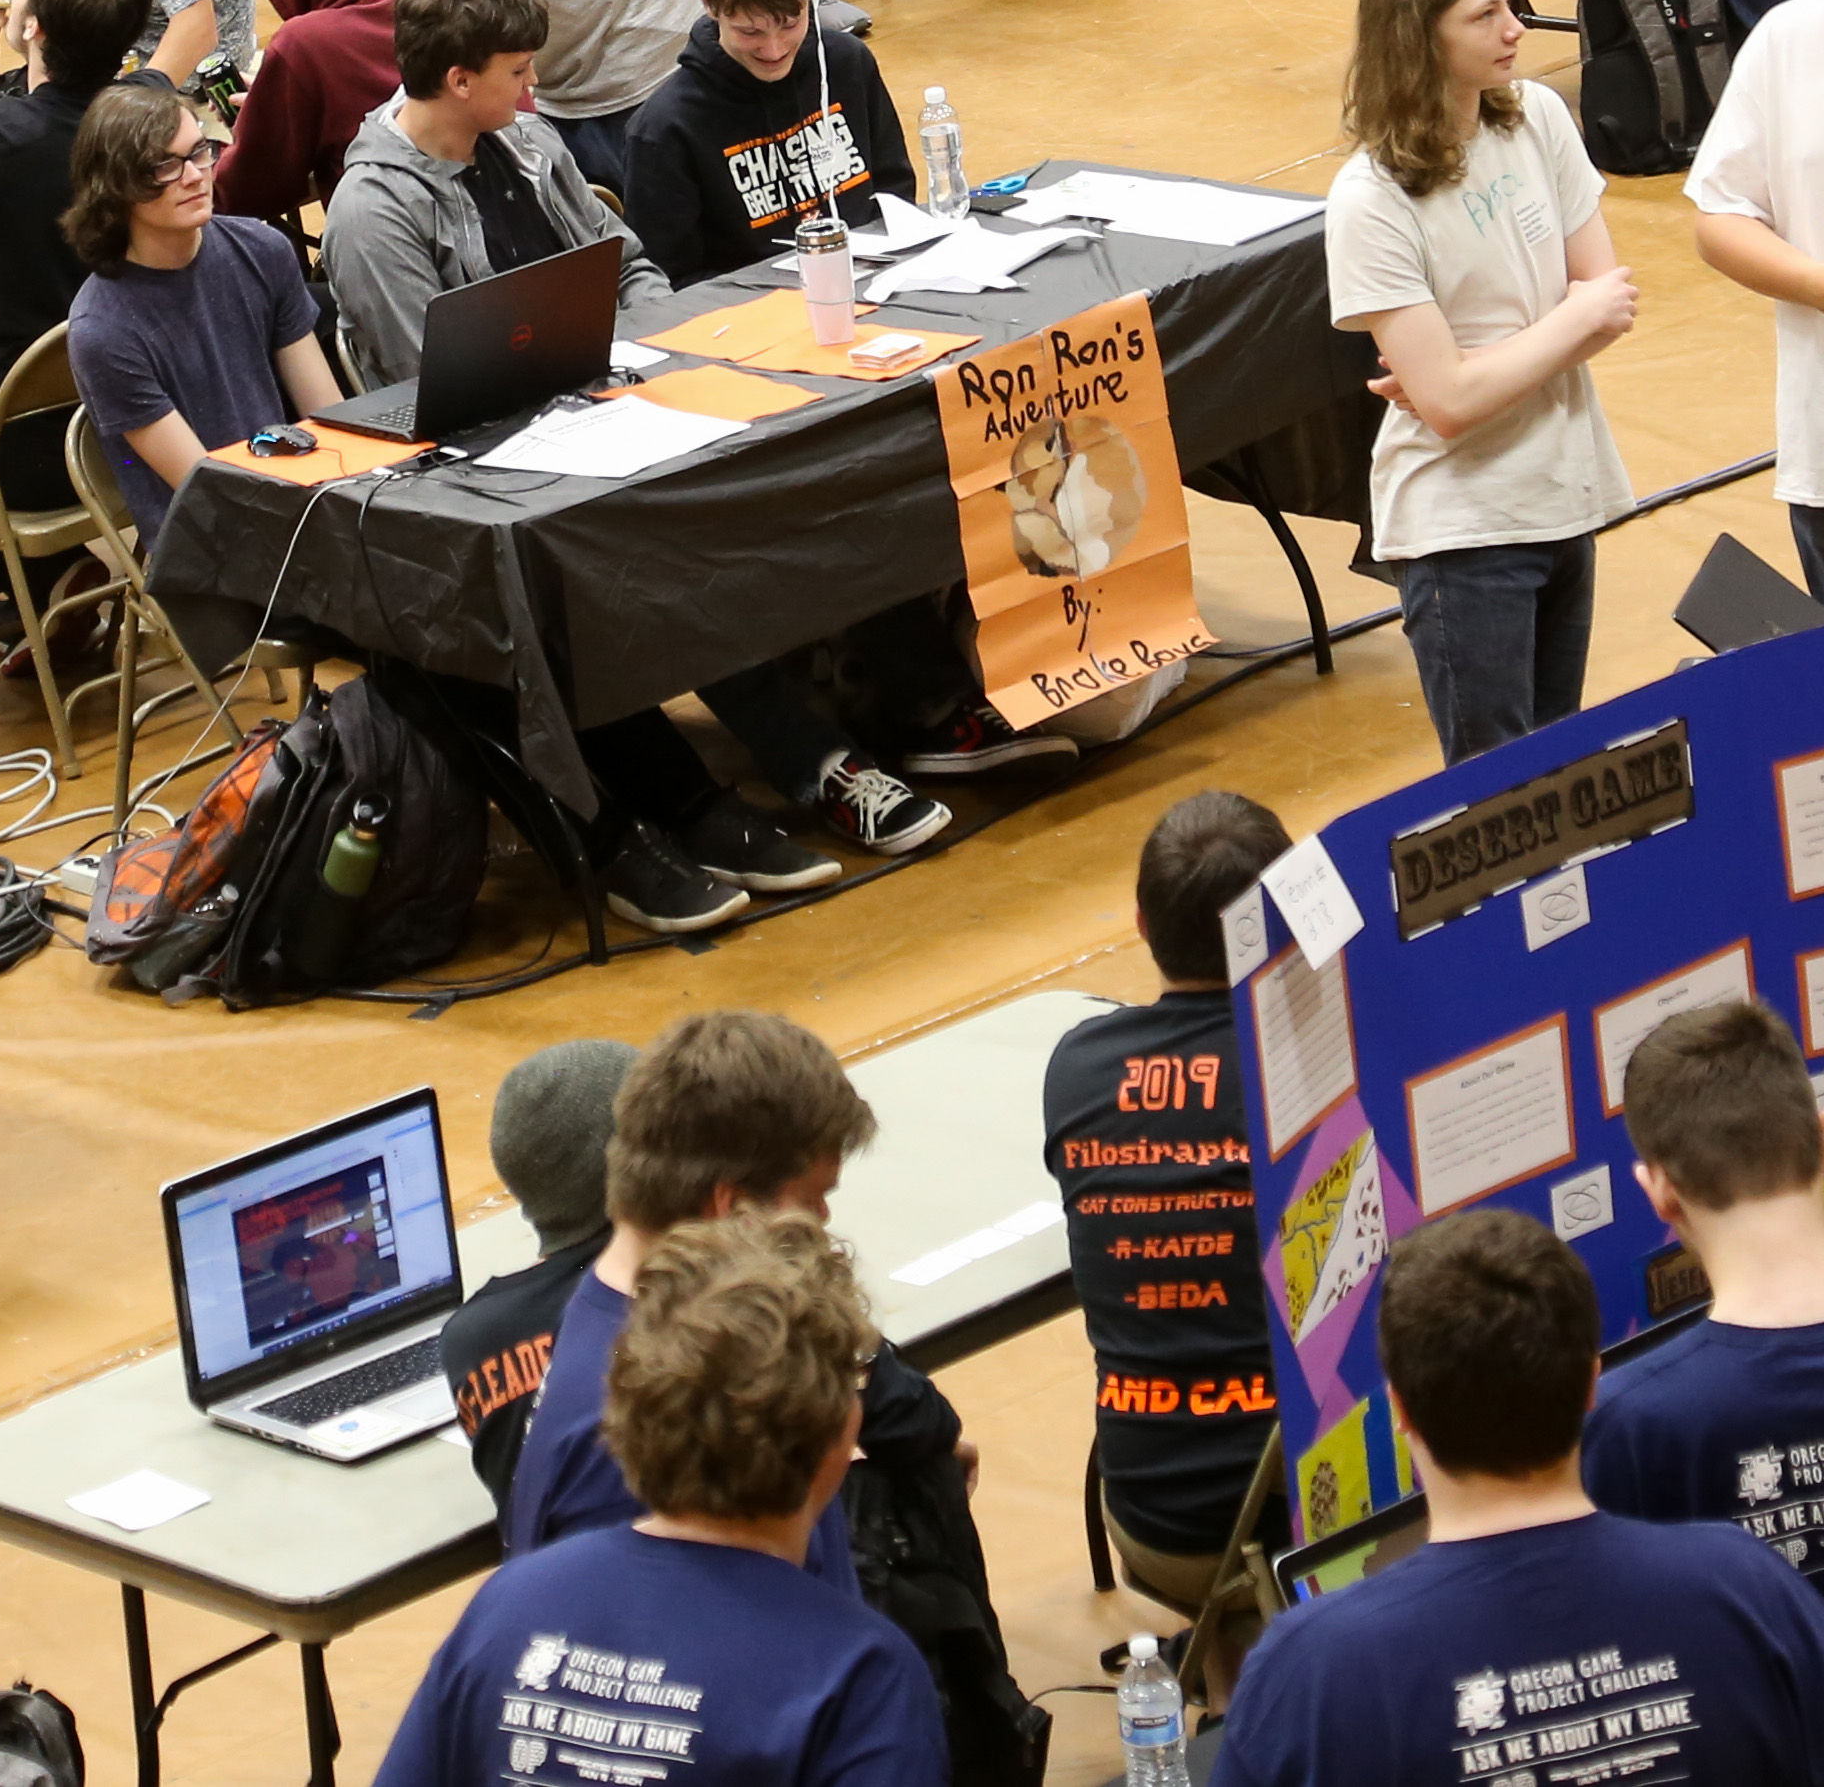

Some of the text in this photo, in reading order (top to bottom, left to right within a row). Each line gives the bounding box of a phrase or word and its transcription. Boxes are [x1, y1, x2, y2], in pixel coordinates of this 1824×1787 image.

[958, 321, 1145, 409] Ron Ron's
[984, 371, 1128, 443] Adventure
[1403, 792, 1562, 906] DESERT
[1573, 740, 1688, 845] GAME
[1117, 1055, 1221, 1112] 2019
[1097, 1374, 1179, 1413] AND
[1782, 1506, 1807, 1531] ME
[560, 1672, 703, 1712] PROJECT CHALLENGE
[568, 1652, 666, 1685] OREGON GAME
[1510, 1649, 1623, 1696] OREGON GAME
[1513, 1659, 1678, 1716] PROJECT CHALLENGE
[501, 1700, 694, 1755] ASK ME ABOUT MY GAME
[1463, 1699, 1692, 1775] ASK ME ABOUT MY GAME
